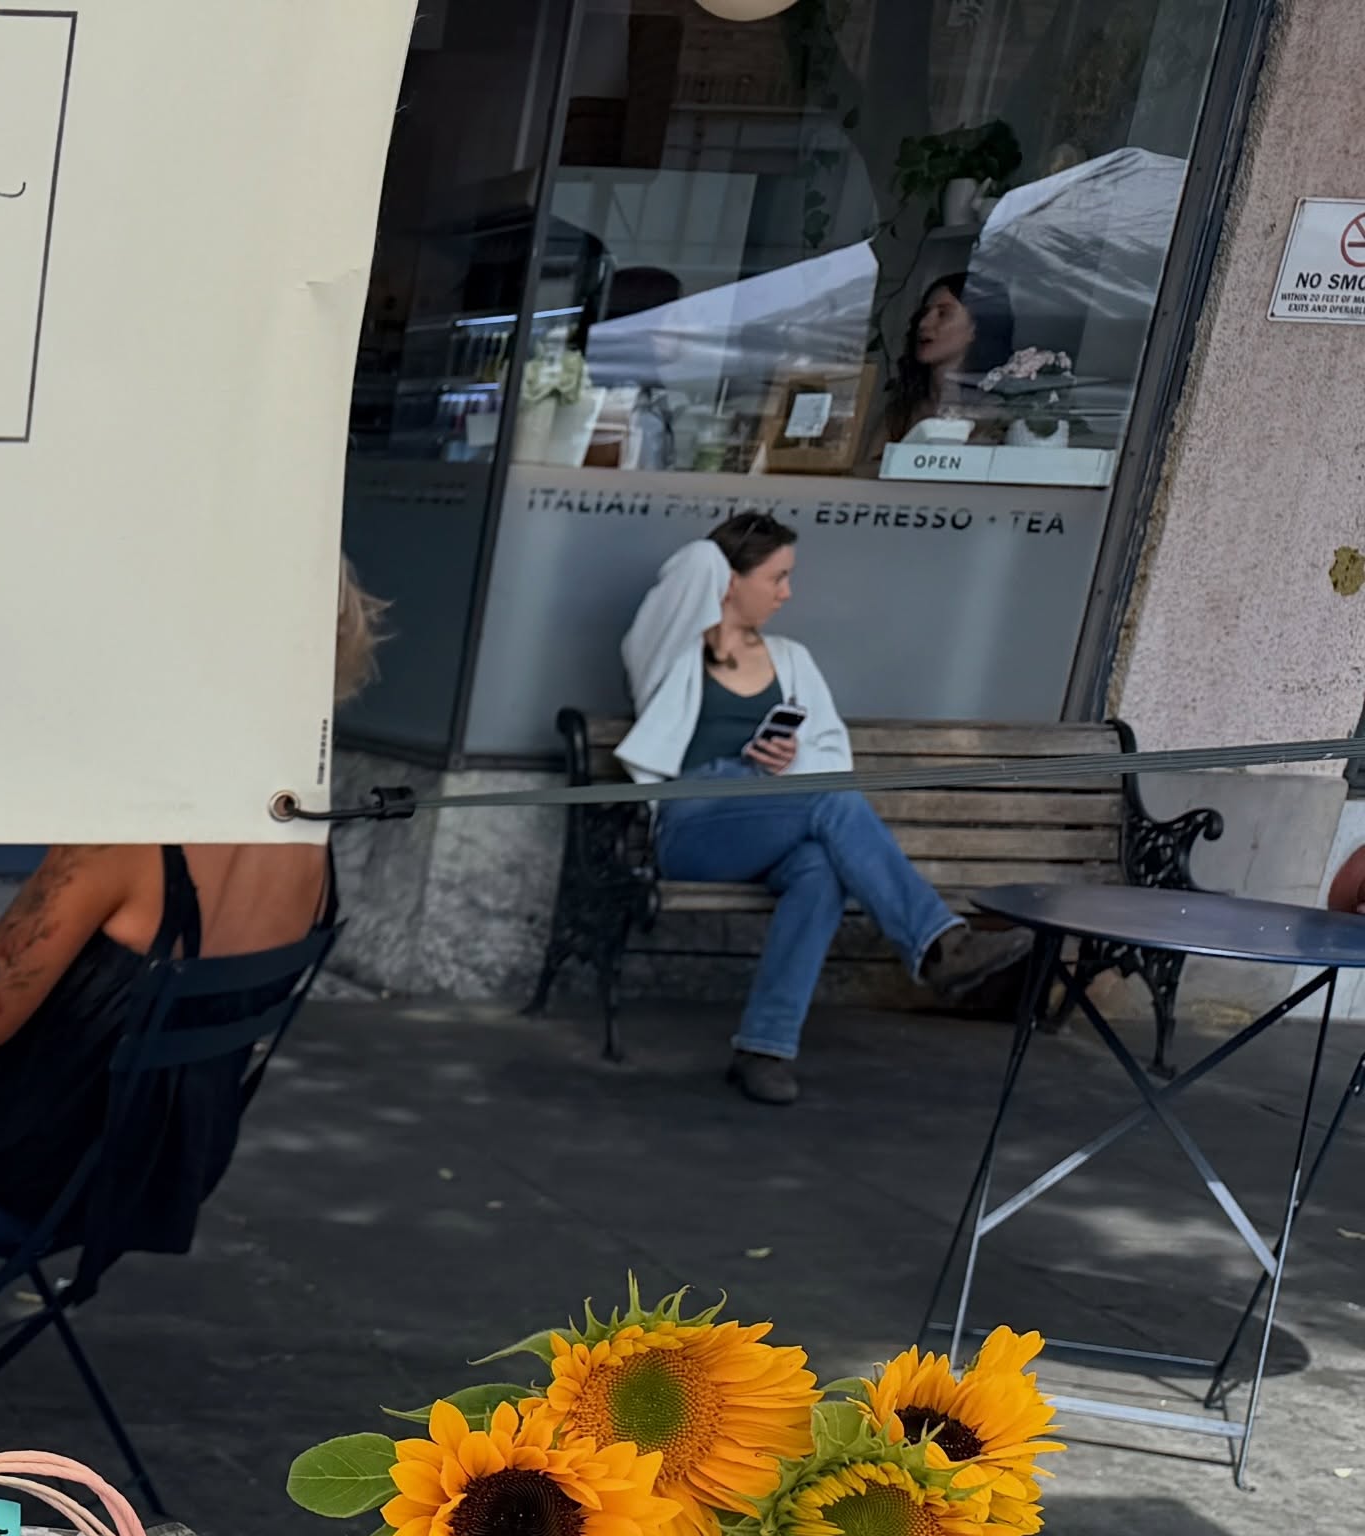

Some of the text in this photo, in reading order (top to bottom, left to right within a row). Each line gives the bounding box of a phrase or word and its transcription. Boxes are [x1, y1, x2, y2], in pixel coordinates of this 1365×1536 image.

[1296, 272, 1322, 289] NO
[1281, 293, 1307, 301] WITHIN
[1309, 294, 1320, 302] 20
[1322, 294, 1339, 303] FEET
[1341, 295, 1352, 303] OF
[1288, 303, 1309, 312] EXITS
[1310, 304, 1327, 313] AND
[913, 455, 962, 470] OPEN
[528, 488, 650, 516] ITALIAN
[815, 501, 973, 530] ESPRESSO
[1011, 512, 1066, 536] TEA
